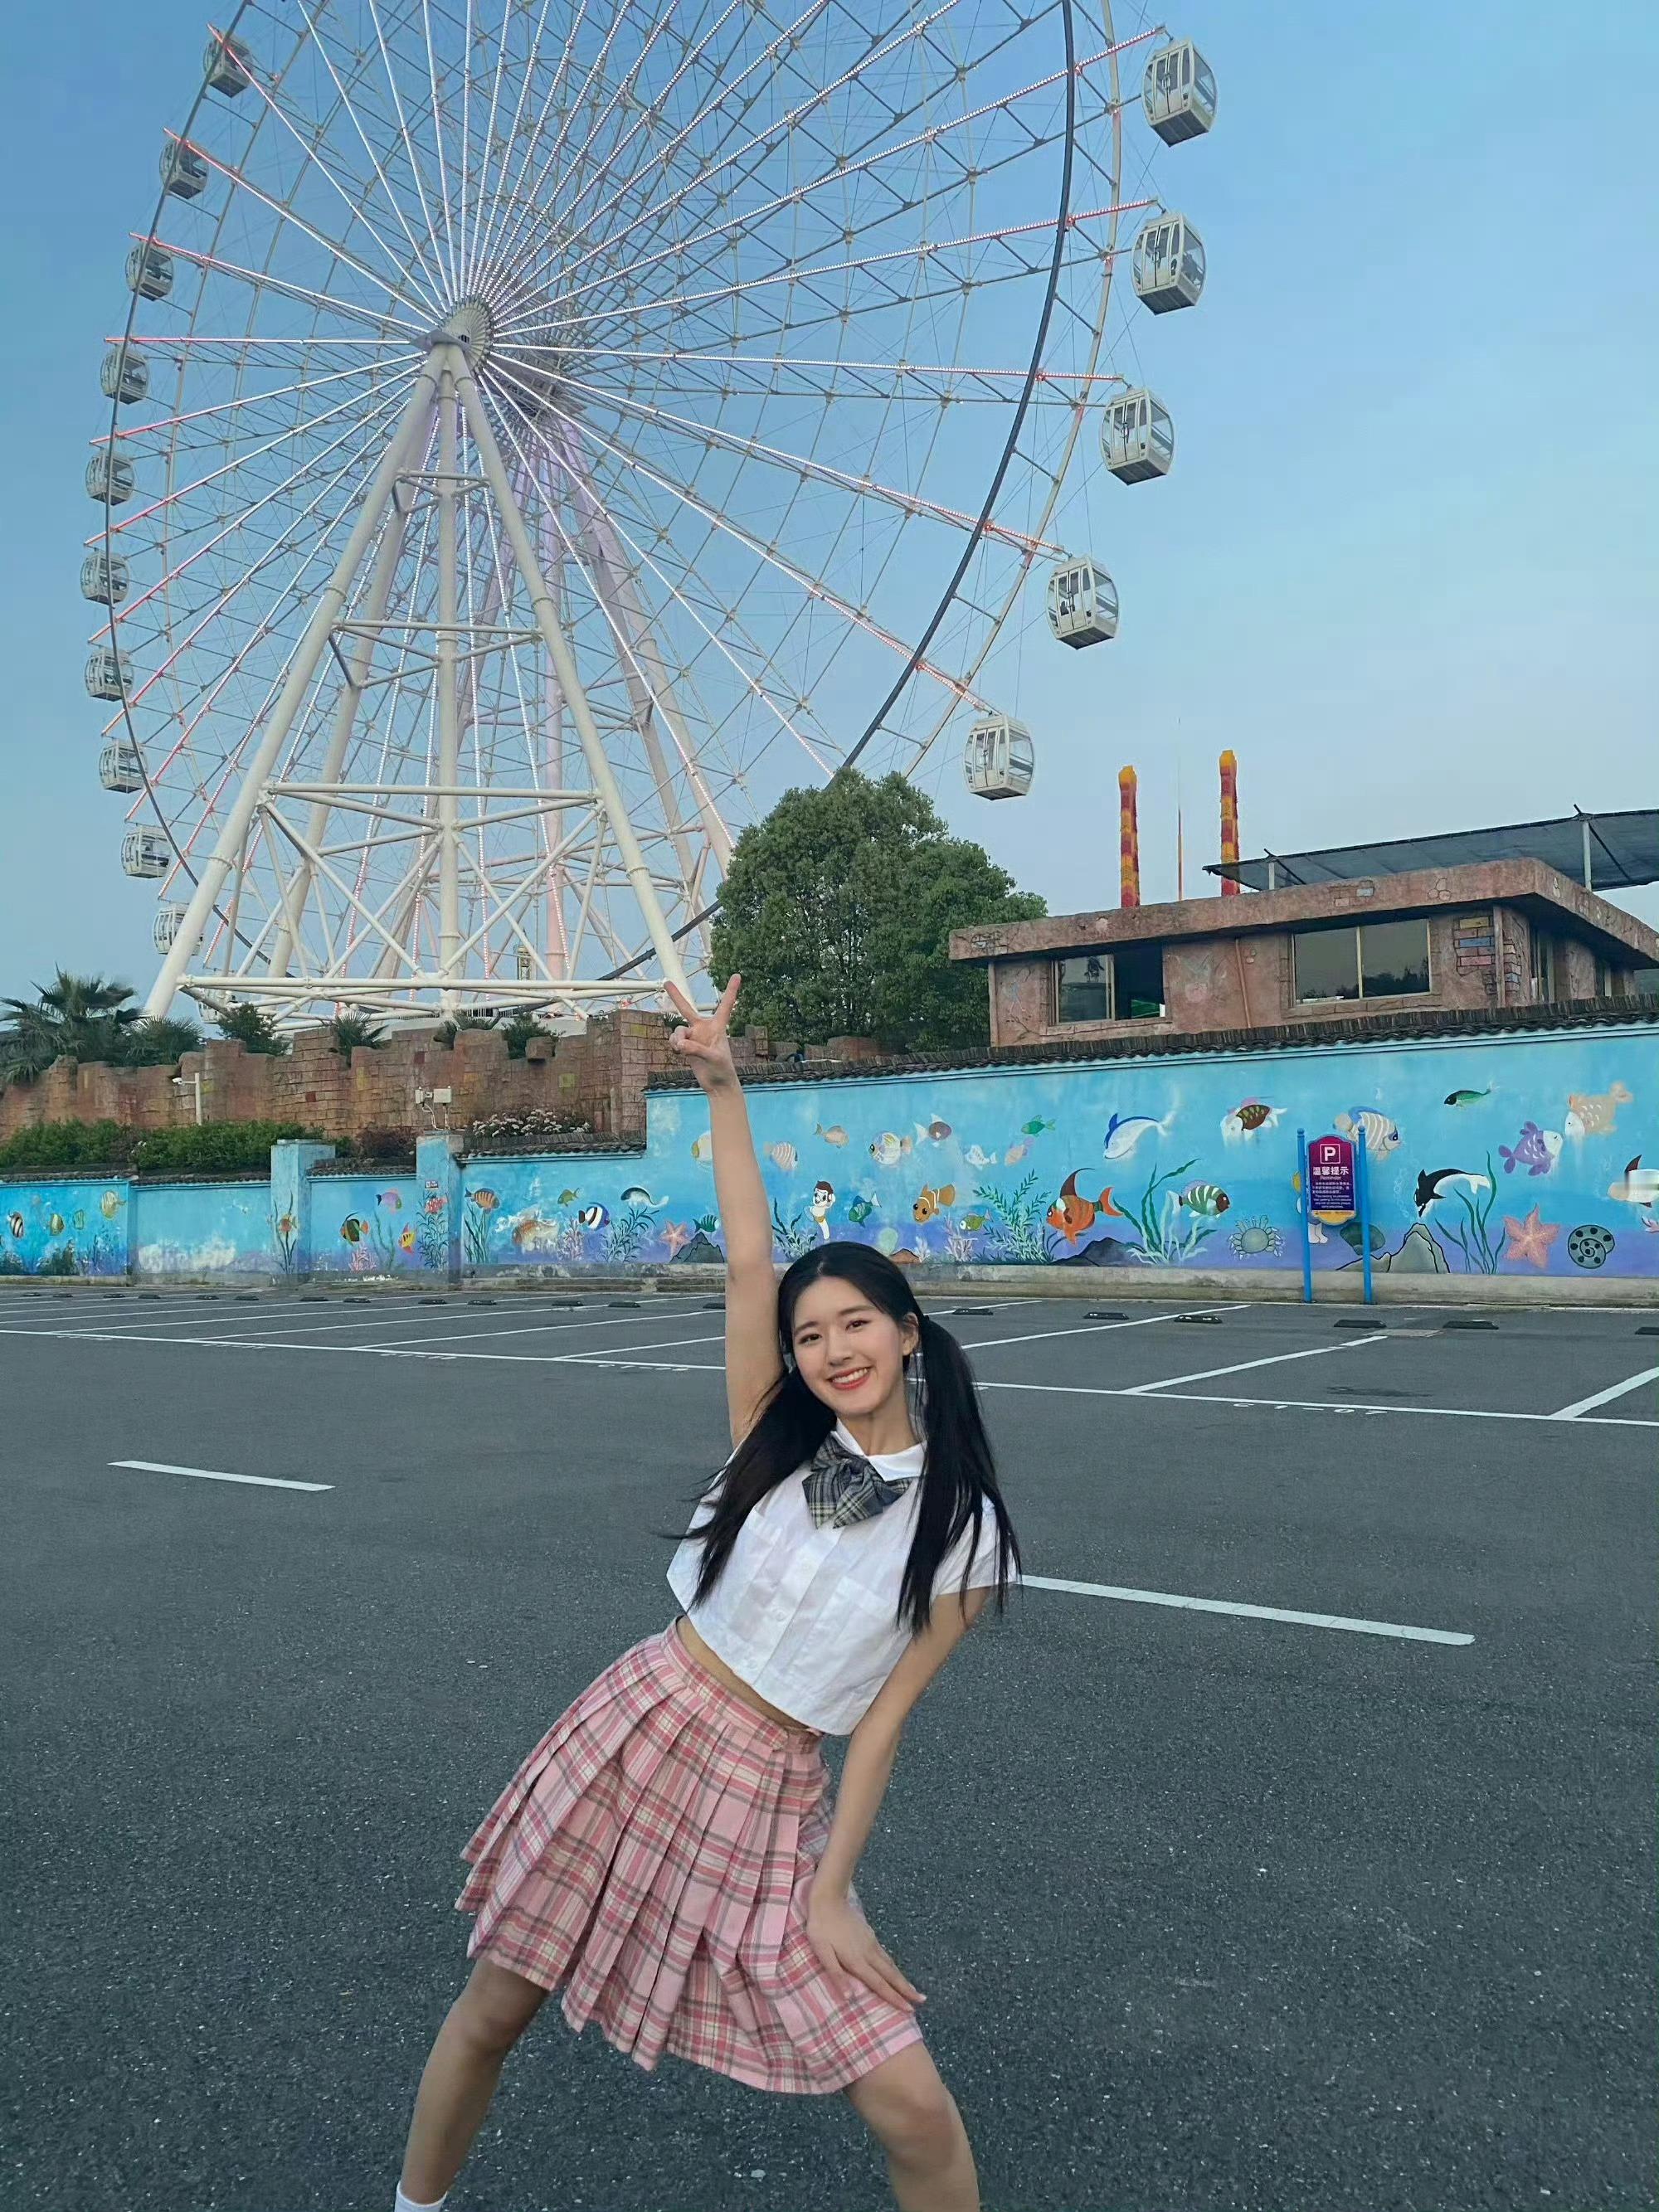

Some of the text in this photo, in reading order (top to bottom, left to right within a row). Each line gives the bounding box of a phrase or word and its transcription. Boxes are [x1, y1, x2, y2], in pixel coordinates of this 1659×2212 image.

[1324, 1146, 1336, 1162] P
[1312, 1166, 1350, 1176] 温馨提示
